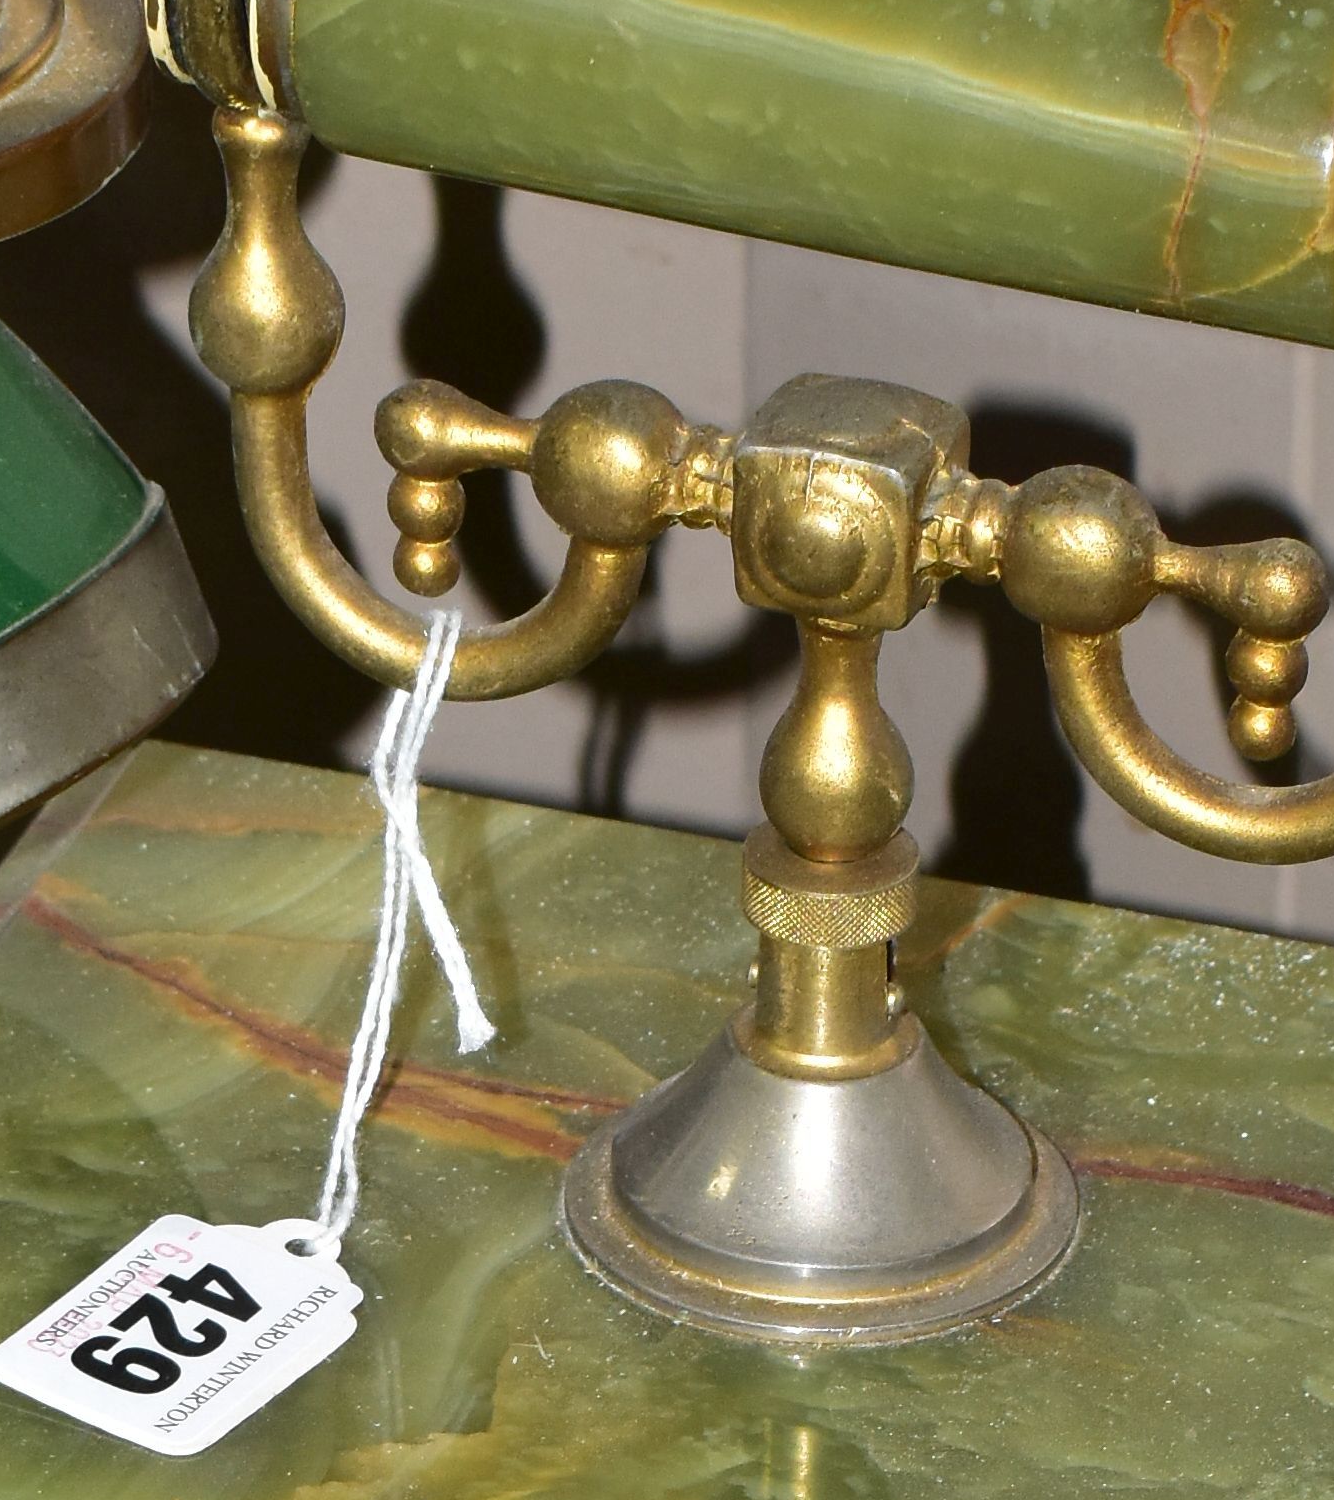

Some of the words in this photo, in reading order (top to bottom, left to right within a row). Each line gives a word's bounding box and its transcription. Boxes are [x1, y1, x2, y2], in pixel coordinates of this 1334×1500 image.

[36, 1249, 157, 1346] AUCTIONEERS
[71, 1263, 262, 1394] 429
[255, 1286, 339, 1350] RICHARD
[153, 1351, 263, 1433] WINTERTON
